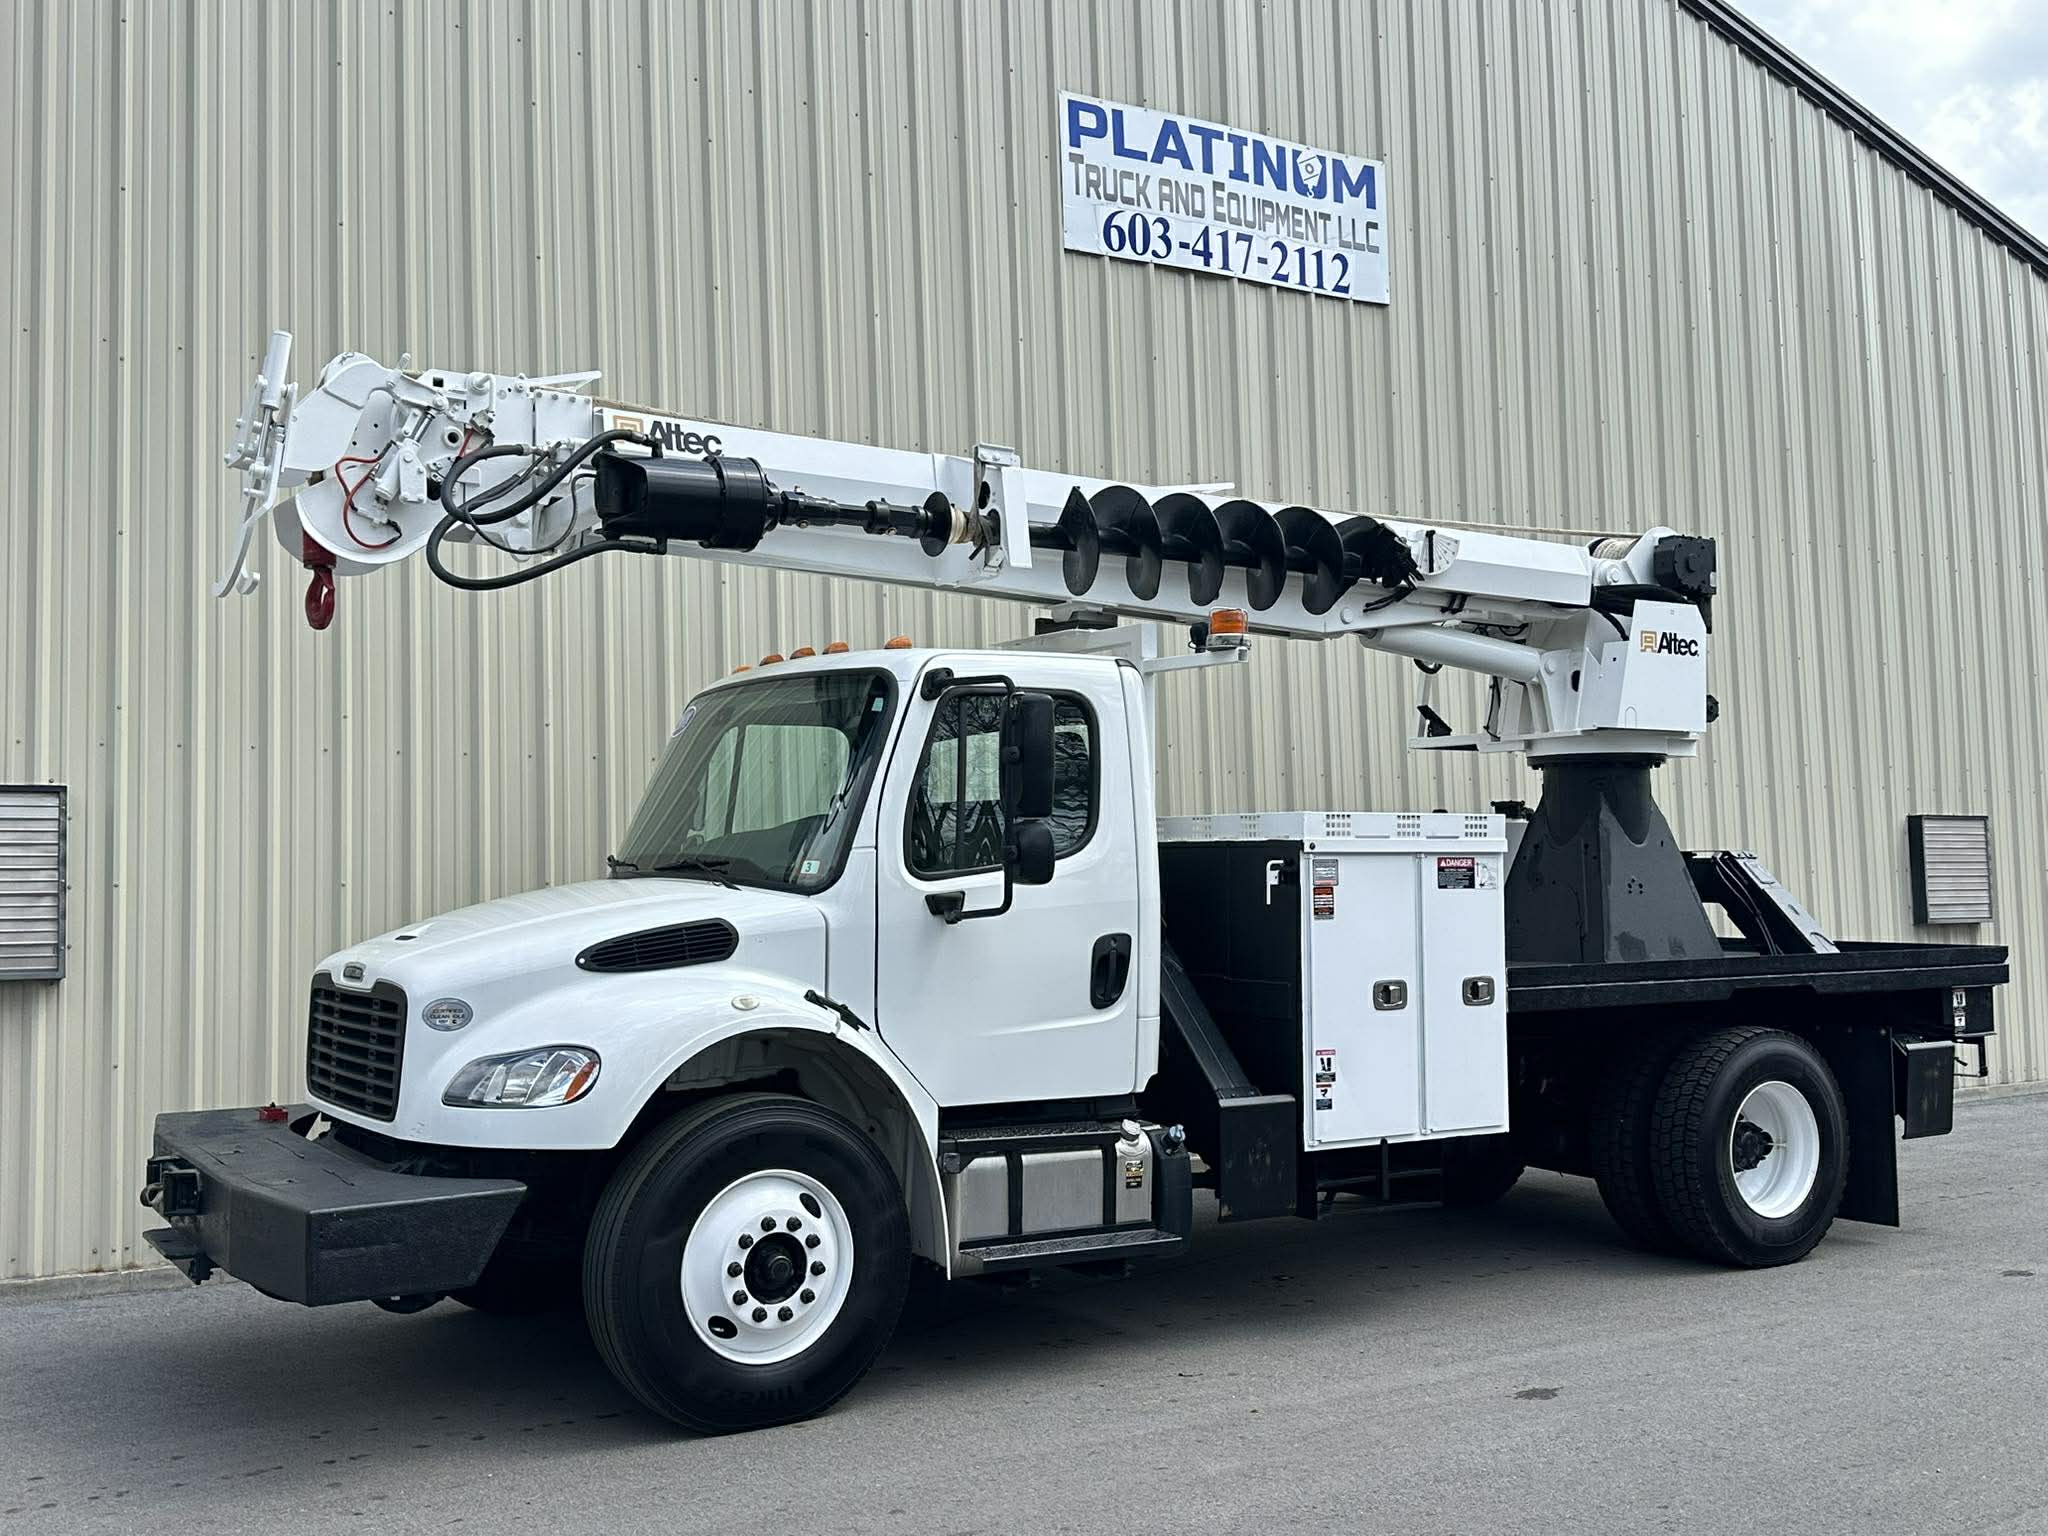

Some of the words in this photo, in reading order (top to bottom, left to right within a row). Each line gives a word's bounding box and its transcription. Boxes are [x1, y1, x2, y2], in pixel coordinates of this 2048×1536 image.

[1067, 99, 1377, 210] PLATINUM
[1068, 152, 1151, 209] TRUCK
[1158, 177, 1206, 219] AND
[1212, 180, 1331, 244] EQUIPMENT
[1337, 215, 1380, 254] LLC
[1102, 209, 1351, 294] 603-417-2112
[648, 420, 722, 456] Altec
[1657, 631, 1699, 657] Altec
[1446, 859, 1473, 867] DANGER
